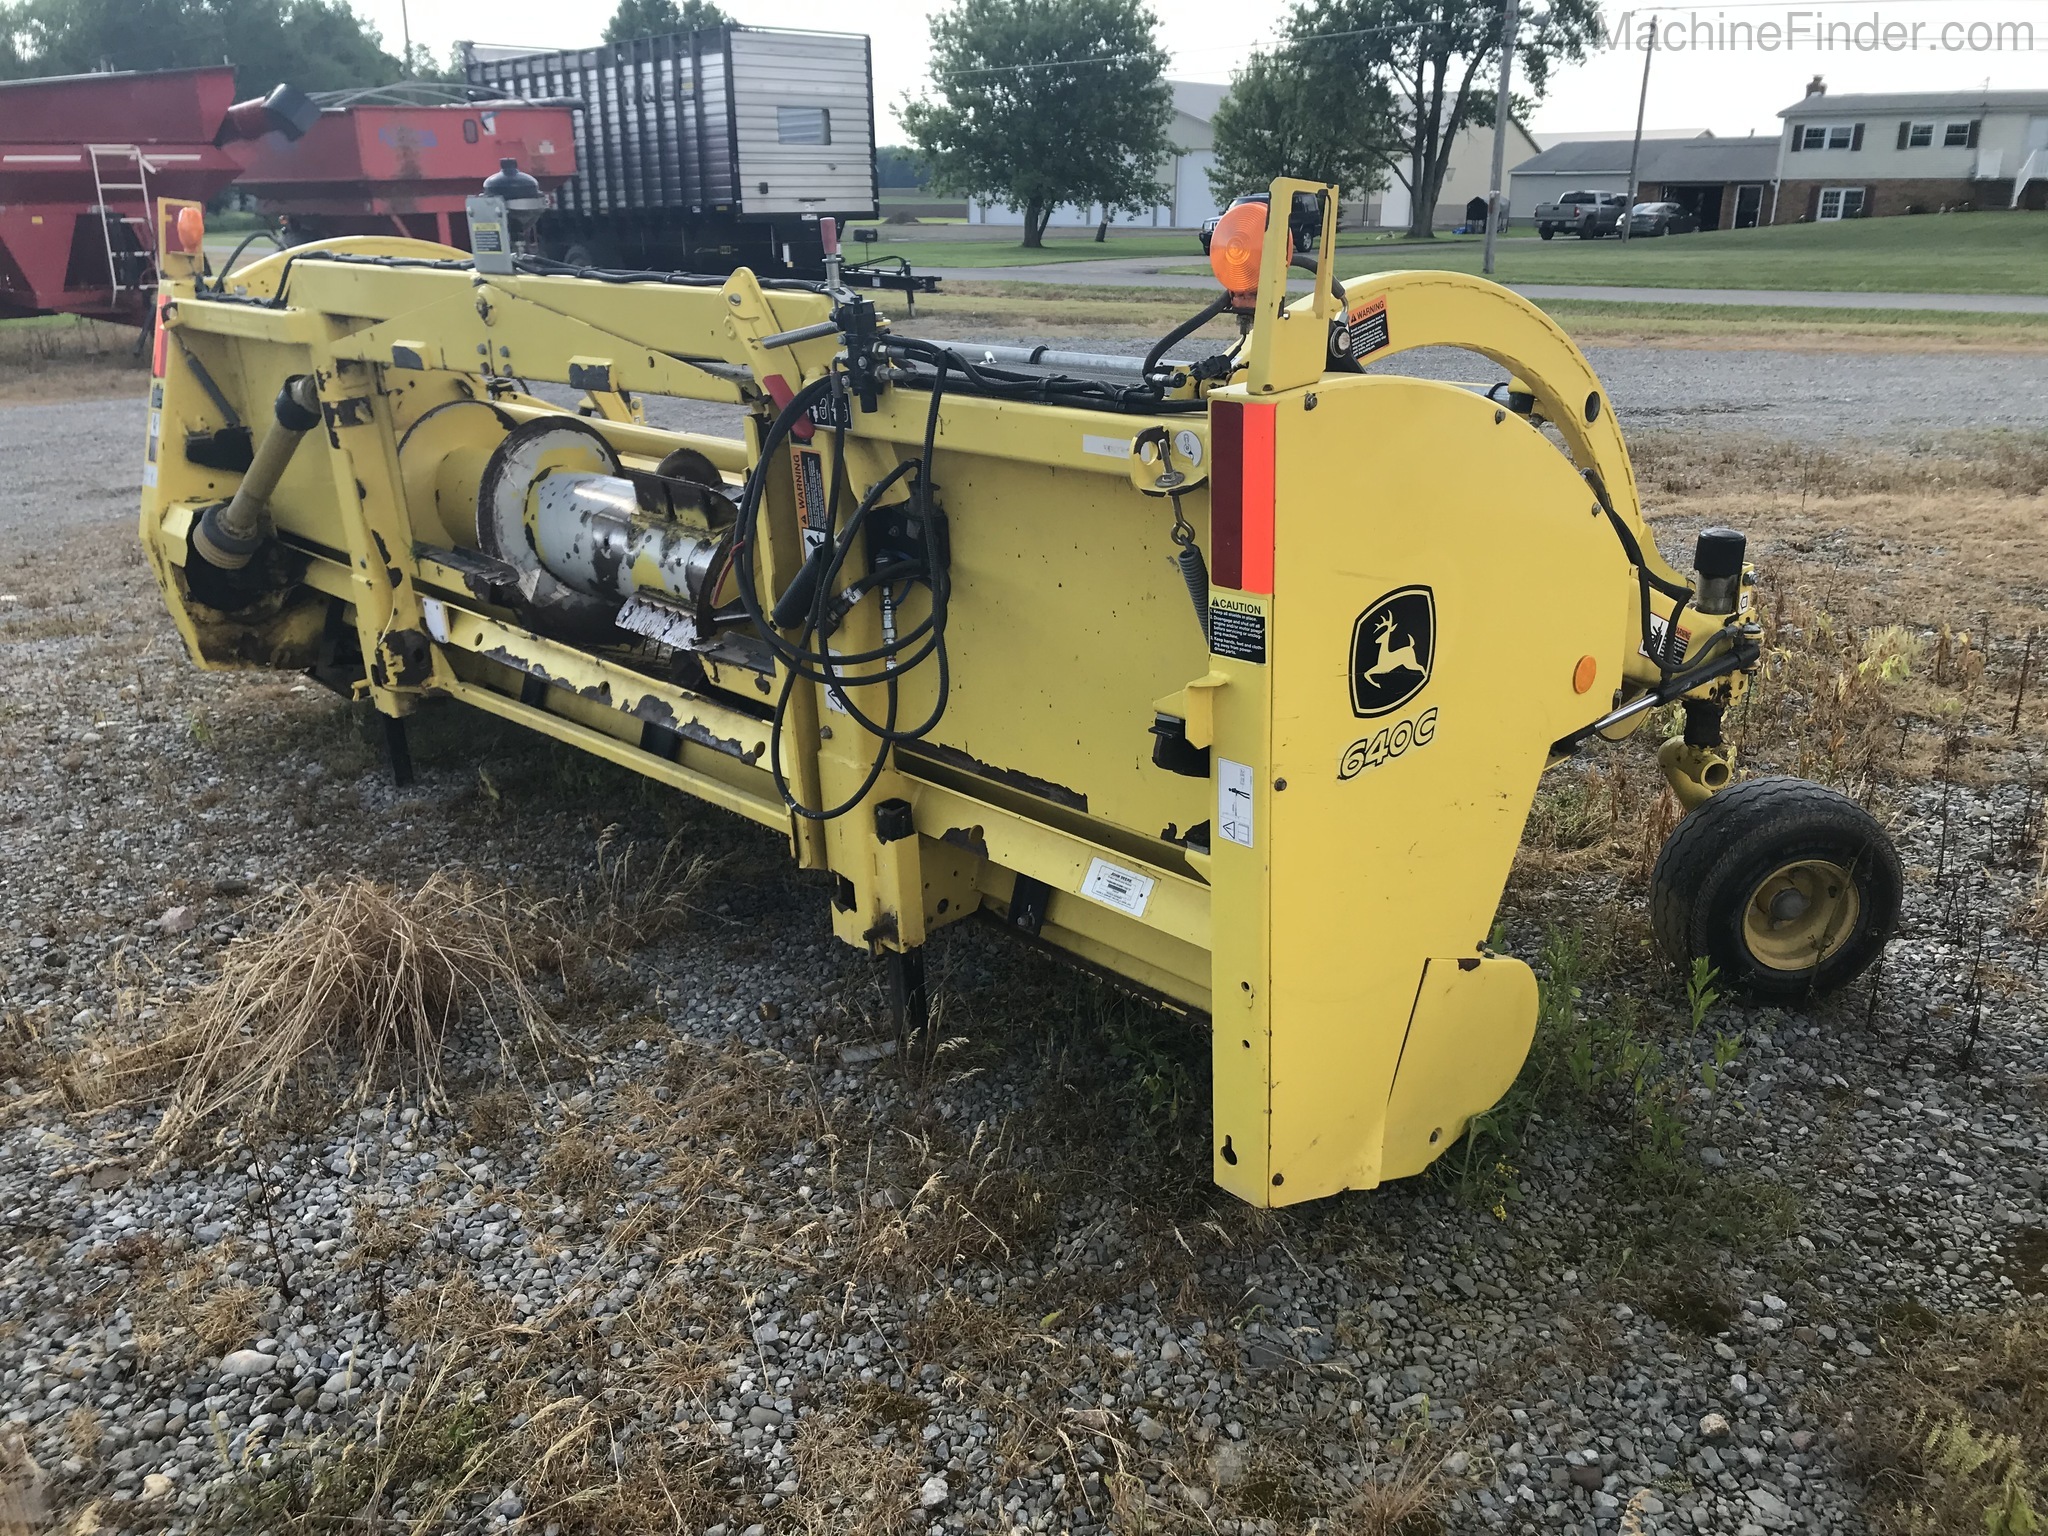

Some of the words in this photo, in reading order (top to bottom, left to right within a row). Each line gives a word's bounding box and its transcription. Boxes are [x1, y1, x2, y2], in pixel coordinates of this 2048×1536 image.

[1357, 300, 1384, 319] WARNING
[793, 454, 805, 509] WARNING
[1220, 599, 1261, 615] CAUTION
[1340, 707, 1438, 780] 640C
